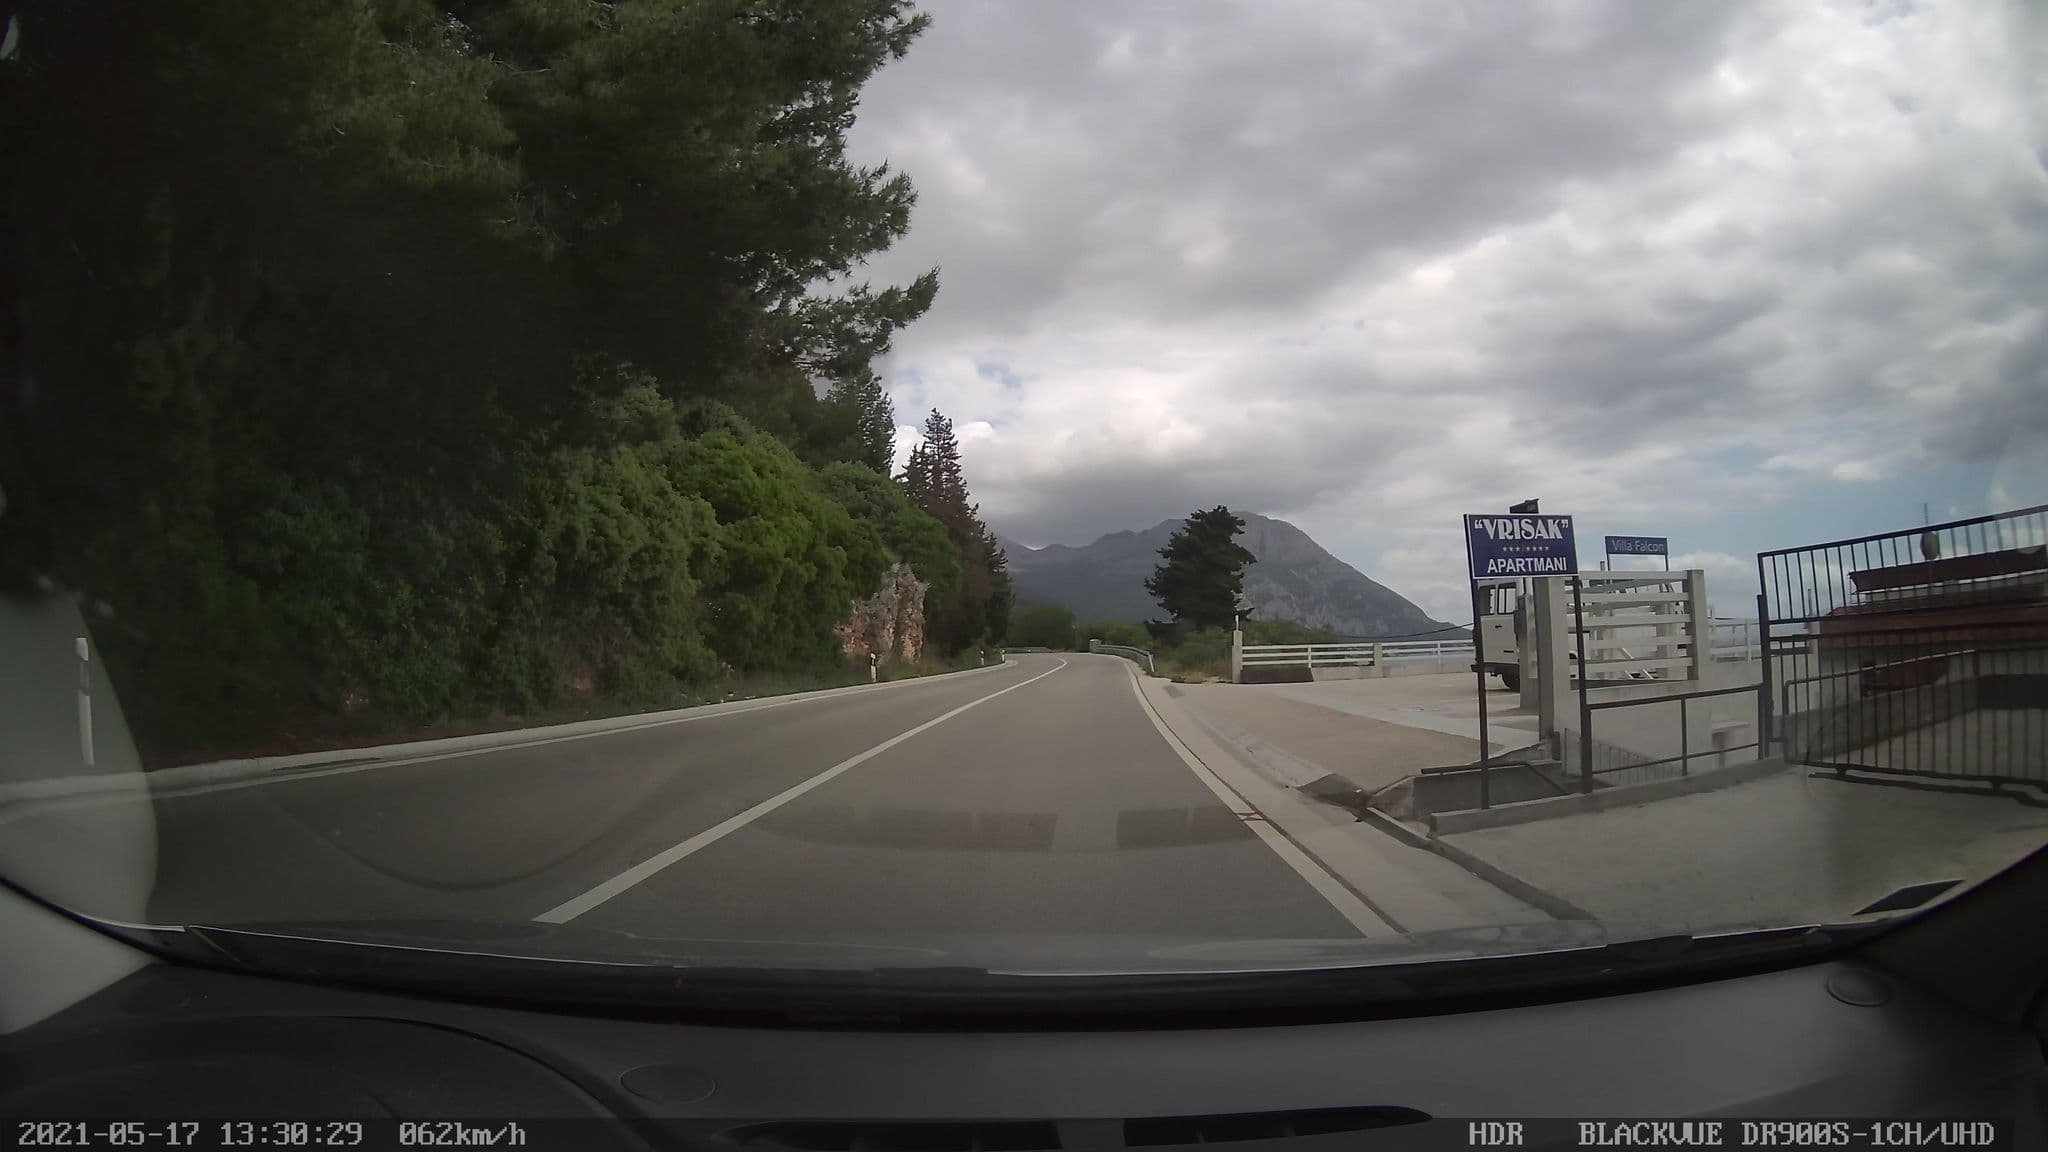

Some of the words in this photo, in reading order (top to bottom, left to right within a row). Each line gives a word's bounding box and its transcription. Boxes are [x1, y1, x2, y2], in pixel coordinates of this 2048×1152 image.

[1612, 539, 1633, 552] Villa
[1635, 540, 1665, 552] Falcon
[1487, 557, 1567, 574] APARTMANI
